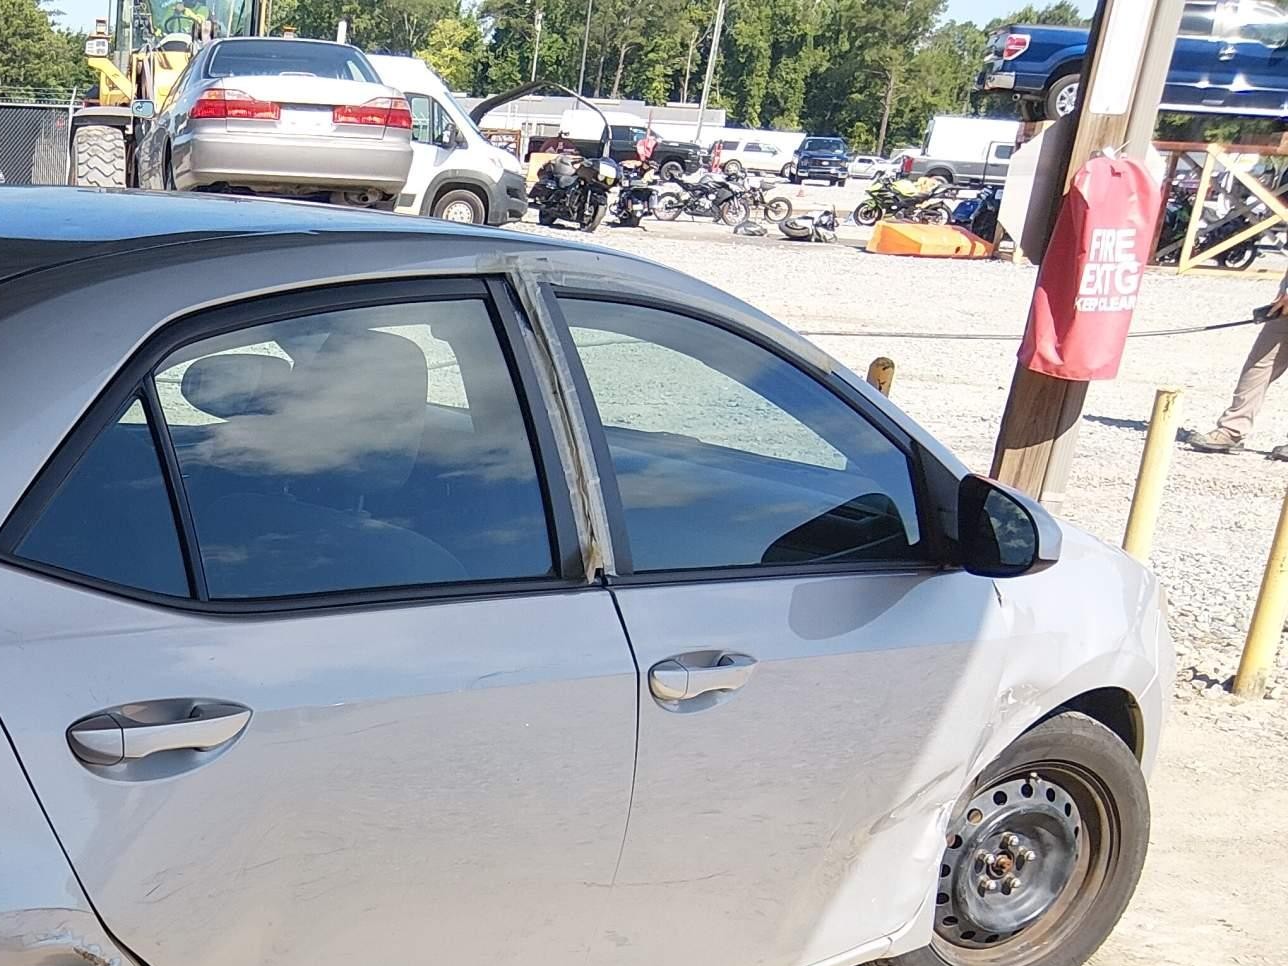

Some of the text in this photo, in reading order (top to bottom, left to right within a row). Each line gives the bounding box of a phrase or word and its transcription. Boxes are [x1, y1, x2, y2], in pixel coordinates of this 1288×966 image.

[1089, 228, 1137, 262] FIRE
[1074, 295, 1137, 312] KEEP CLEAR
